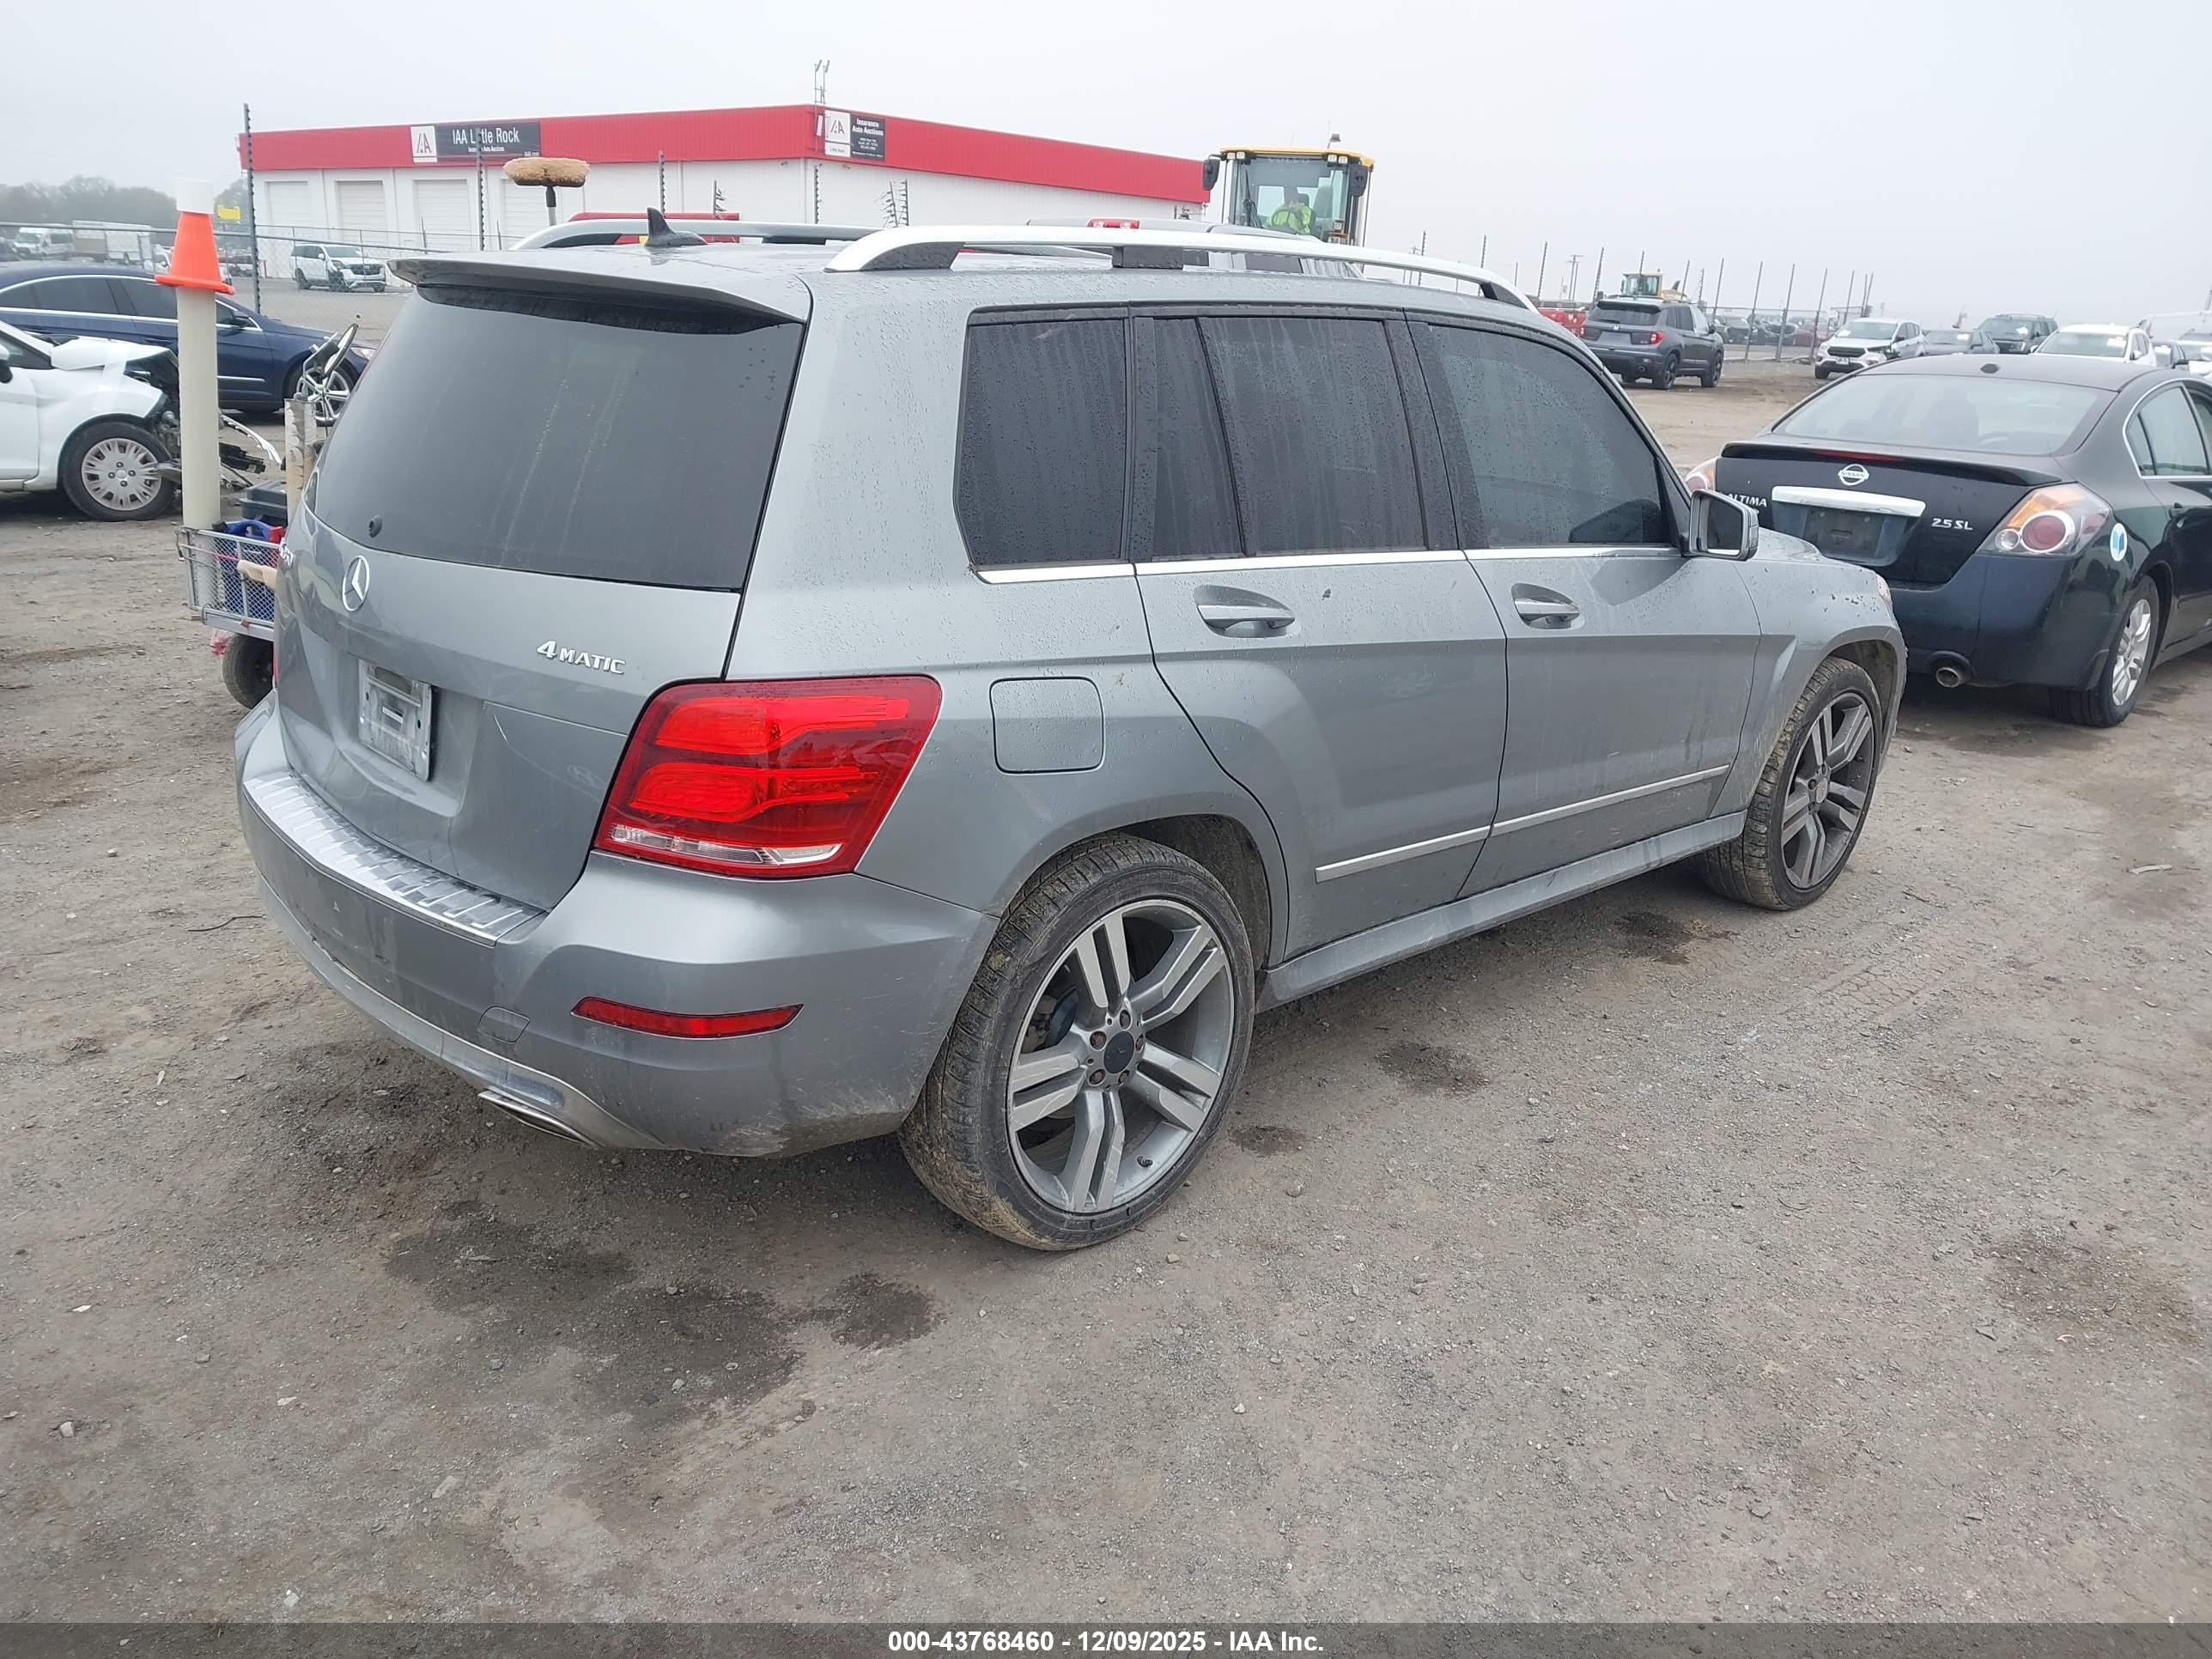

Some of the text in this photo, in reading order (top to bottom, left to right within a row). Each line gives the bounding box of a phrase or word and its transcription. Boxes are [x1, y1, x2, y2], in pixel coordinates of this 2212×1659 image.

[453, 127, 520, 144] IAA Ltle Rock
[1954, 520, 1974, 531] SL
